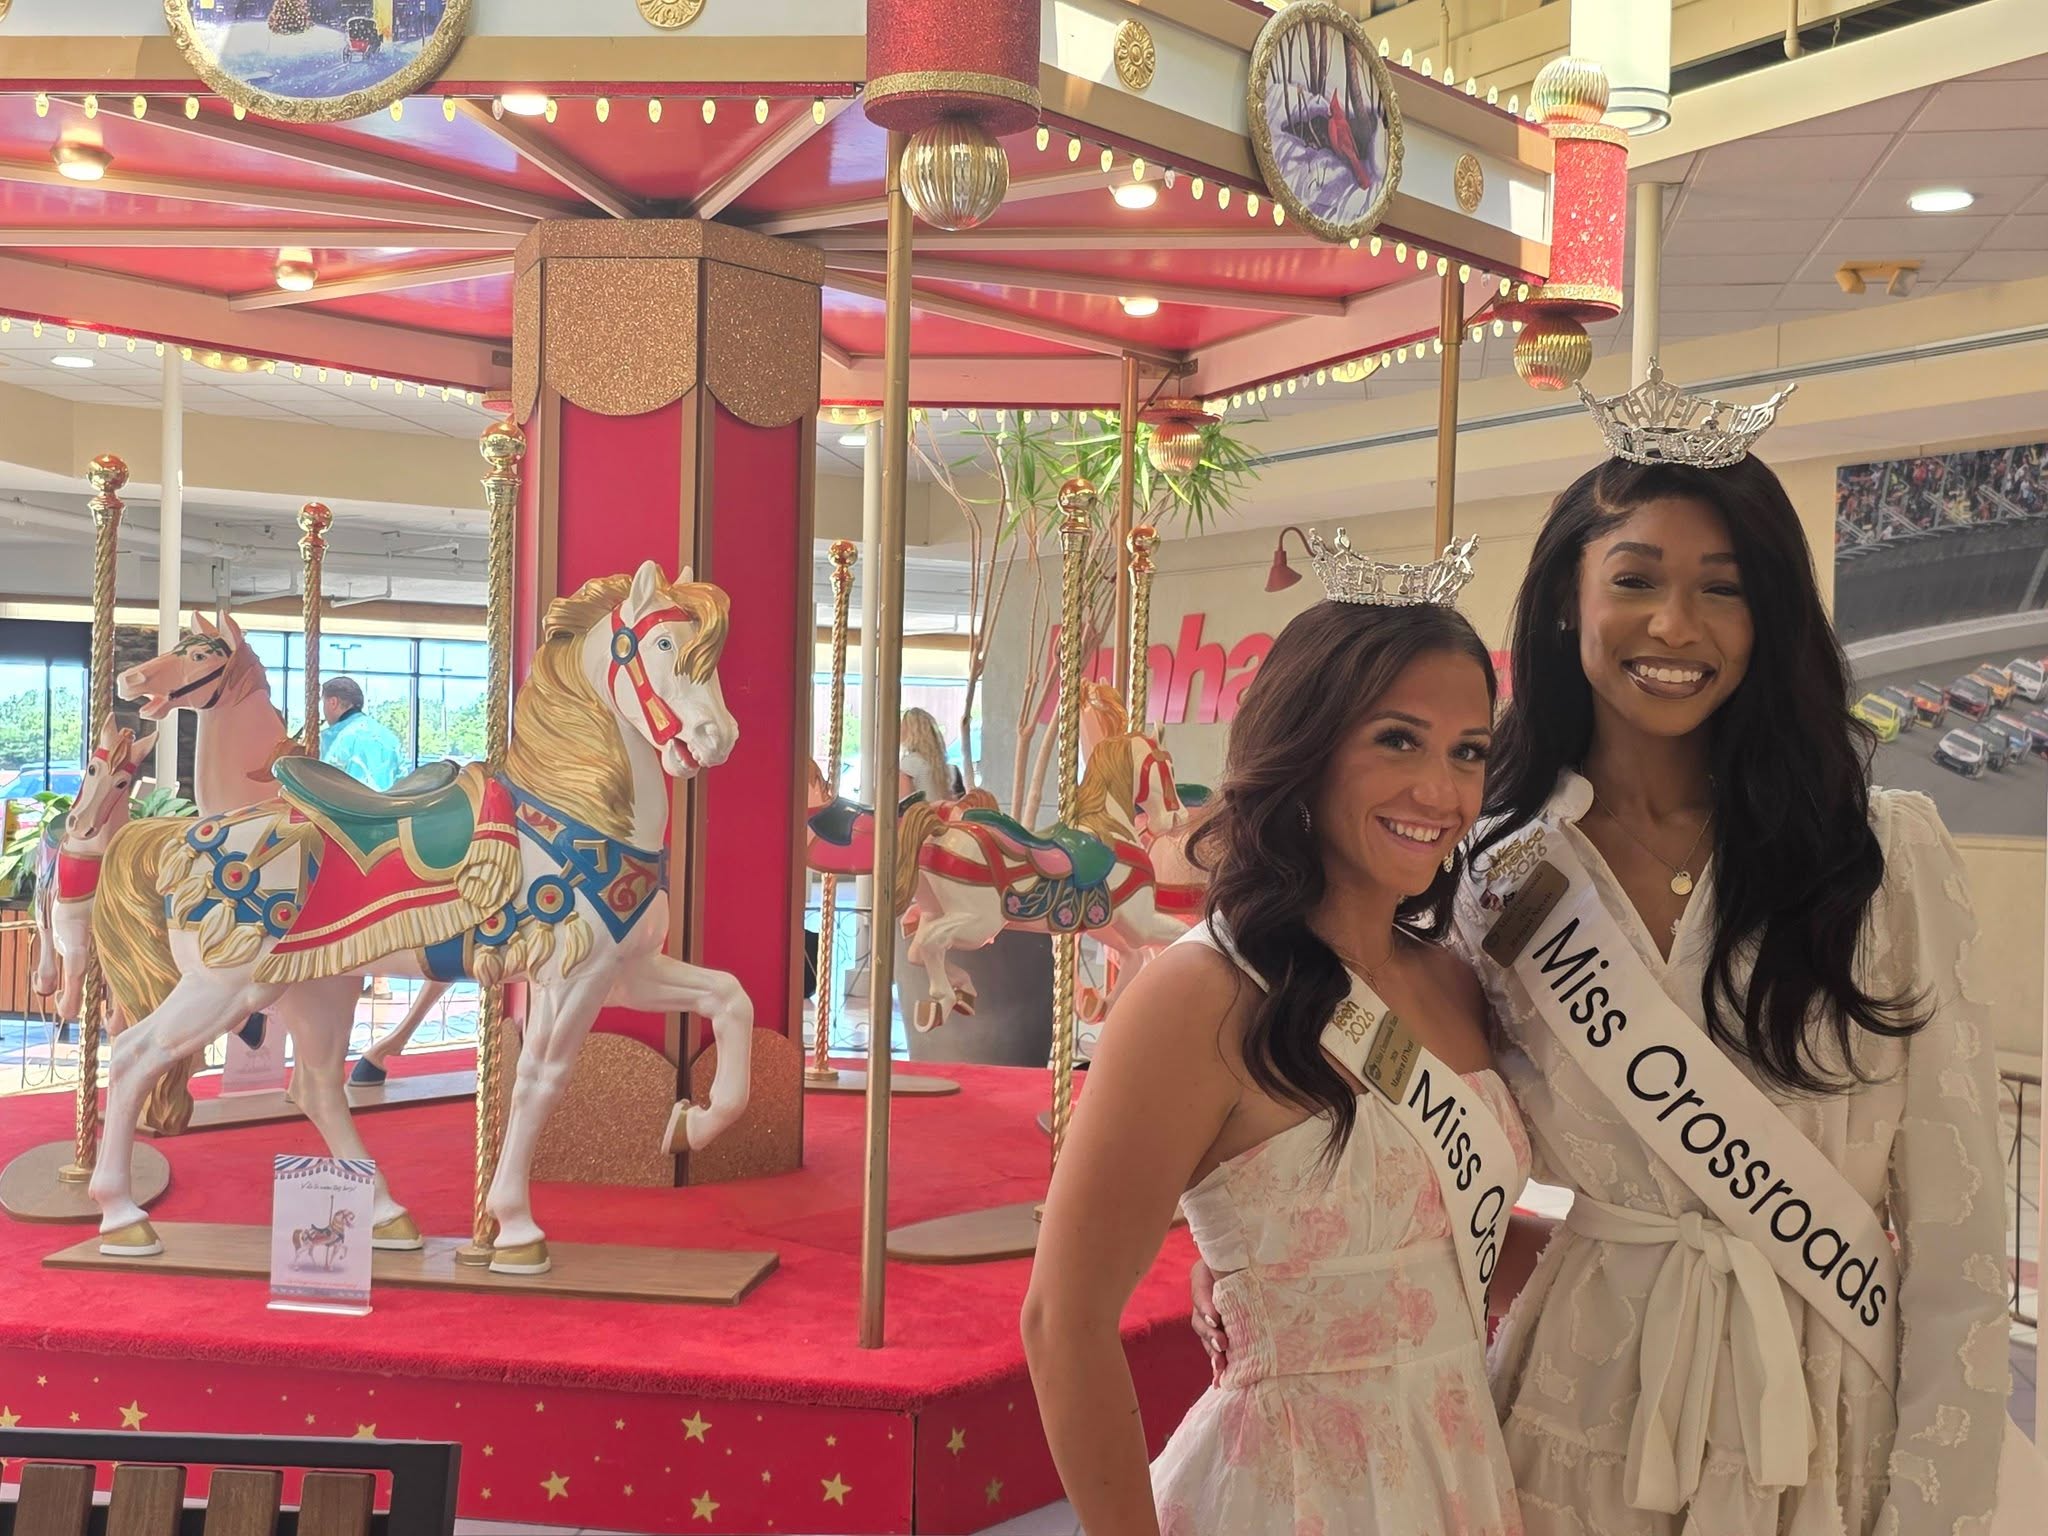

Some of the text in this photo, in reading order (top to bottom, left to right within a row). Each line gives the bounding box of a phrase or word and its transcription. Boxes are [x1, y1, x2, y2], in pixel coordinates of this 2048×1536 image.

[1507, 843, 1548, 883] 2026
[1344, 1008, 1376, 1044] 2026
[1407, 1069, 1482, 1191] Miss
[1532, 917, 1887, 1326] Miss Crossroads
